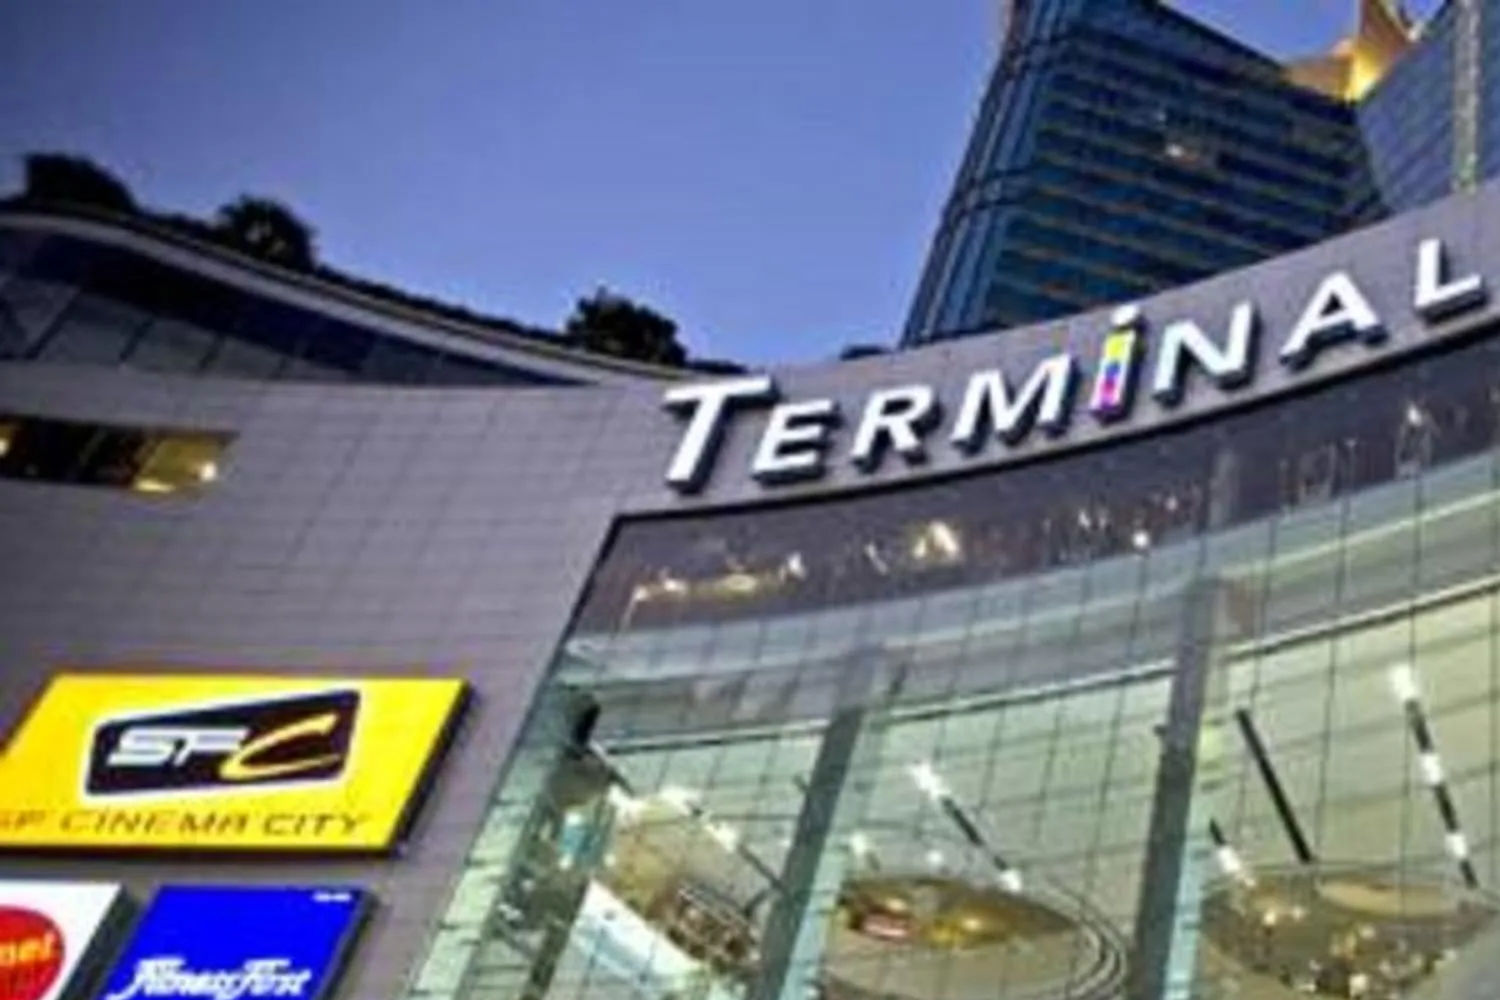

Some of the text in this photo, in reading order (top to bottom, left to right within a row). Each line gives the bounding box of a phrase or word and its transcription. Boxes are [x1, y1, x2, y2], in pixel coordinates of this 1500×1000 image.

[663, 238, 1484, 488] TERMINAL
[107, 713, 341, 780] SFC
[60, 808, 248, 834] CINEMA
[264, 811, 366, 835] CITY
